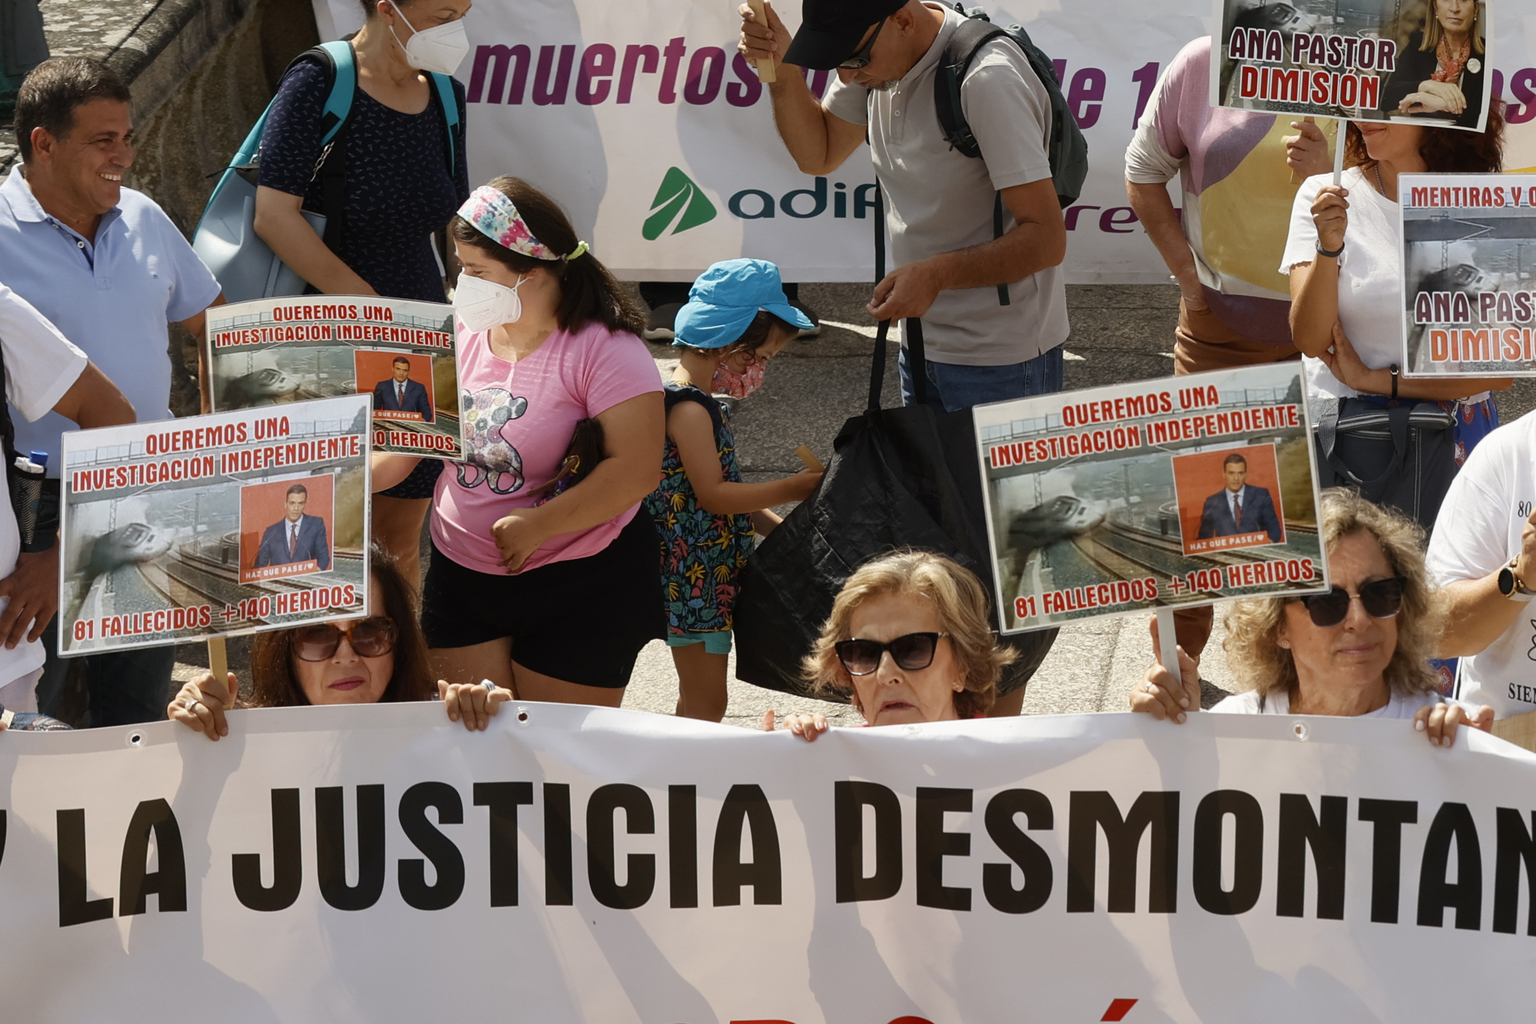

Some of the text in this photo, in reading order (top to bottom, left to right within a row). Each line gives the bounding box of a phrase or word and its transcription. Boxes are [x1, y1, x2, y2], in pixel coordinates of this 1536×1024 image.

[1230, 28, 1396, 71] ANA PASTOR
[466, 36, 763, 108] muertos
[1240, 66, 1379, 110] DIMISIÓN
[728, 176, 877, 219] adif
[1411, 186, 1505, 207] MENTIRAS
[273, 305, 393, 322] QUEREMOS UNA
[1416, 292, 1470, 323] ANA
[216, 322, 451, 348] INVESTIGACIÓN INDEPENDIENTE
[1062, 385, 1219, 427] QUEREMOS UNA
[145, 416, 290, 455] QUEREMOS UNA
[391, 432, 455, 451] HERIDOS
[990, 405, 1299, 468] INVESTIGACIÓN INDEPENDIENTE
[72, 435, 360, 492] INVESTIGACIÓN INDEPENDIENTE
[1015, 559, 1314, 619] 81 FALLECIDOS HERIDOS
[74, 584, 355, 640] 81 FALLECIDOS HERIDOS
[56, 798, 188, 928] LA
[231, 781, 783, 913] JUSTICIA
